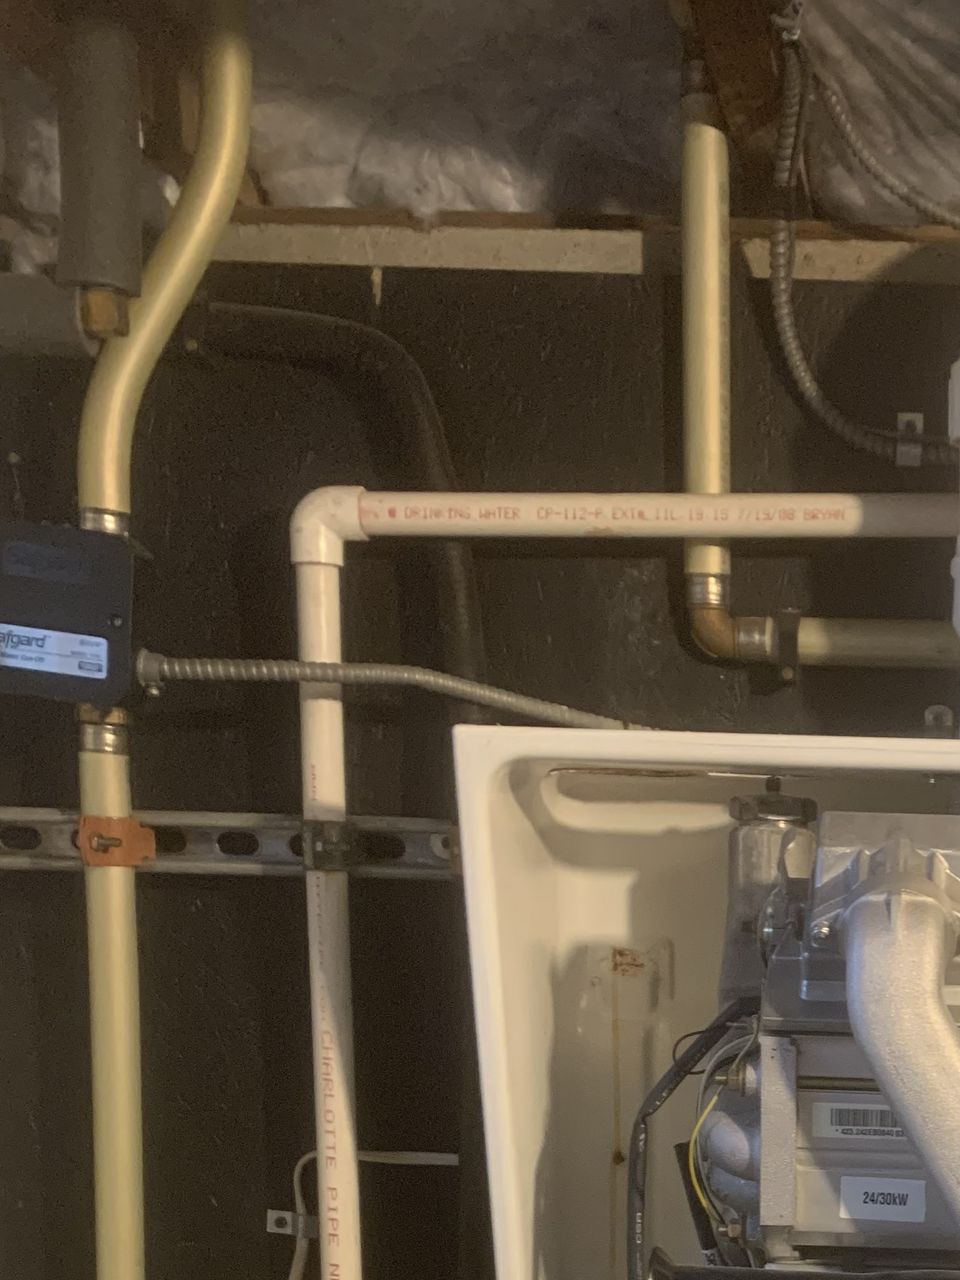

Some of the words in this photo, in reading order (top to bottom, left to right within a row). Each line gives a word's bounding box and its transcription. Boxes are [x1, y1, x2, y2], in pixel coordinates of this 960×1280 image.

[478, 506, 521, 521] WATER
[321, 1030, 337, 1170] CHARLOTTE
[327, 1186, 341, 1248] PIPE
[861, 1191, 908, 1206] 24/30kW
